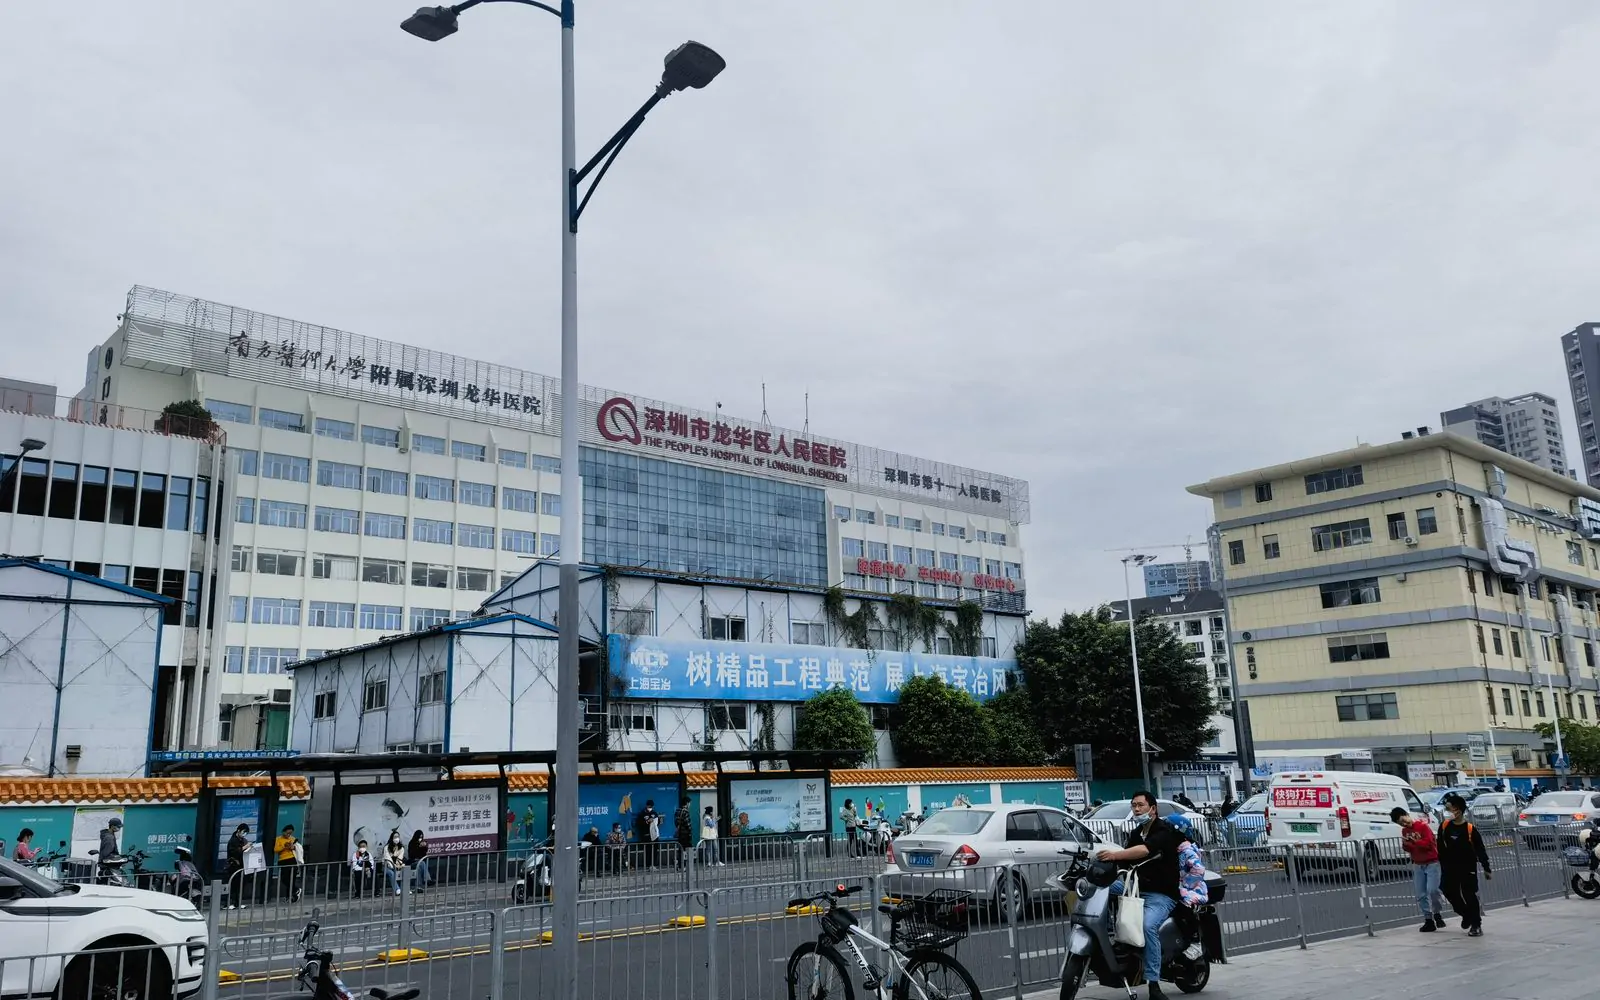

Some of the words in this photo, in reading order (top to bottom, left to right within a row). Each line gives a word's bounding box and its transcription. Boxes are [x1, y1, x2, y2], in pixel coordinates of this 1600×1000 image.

[643, 406, 847, 469] 深圳市龙华区人民医院
[643, 435, 663, 449] THE
[665, 441, 709, 458] PEOPLE'S
[710, 449, 752, 465] HOSPITAL
[753, 457, 765, 467] OF
[808, 467, 848, 484] SHENZHEN
[884, 467, 1002, 504] 深圳市第十一人民医院
[629, 676, 672, 691] 上海宝冶
[685, 649, 871, 693] 树精品工程典范
[1275, 789, 1317, 800] 快狗打车
[428, 811, 459, 823] 坐月子
[462, 808, 492, 821] 到宝生
[445, 839, 491, 852] 22922888
